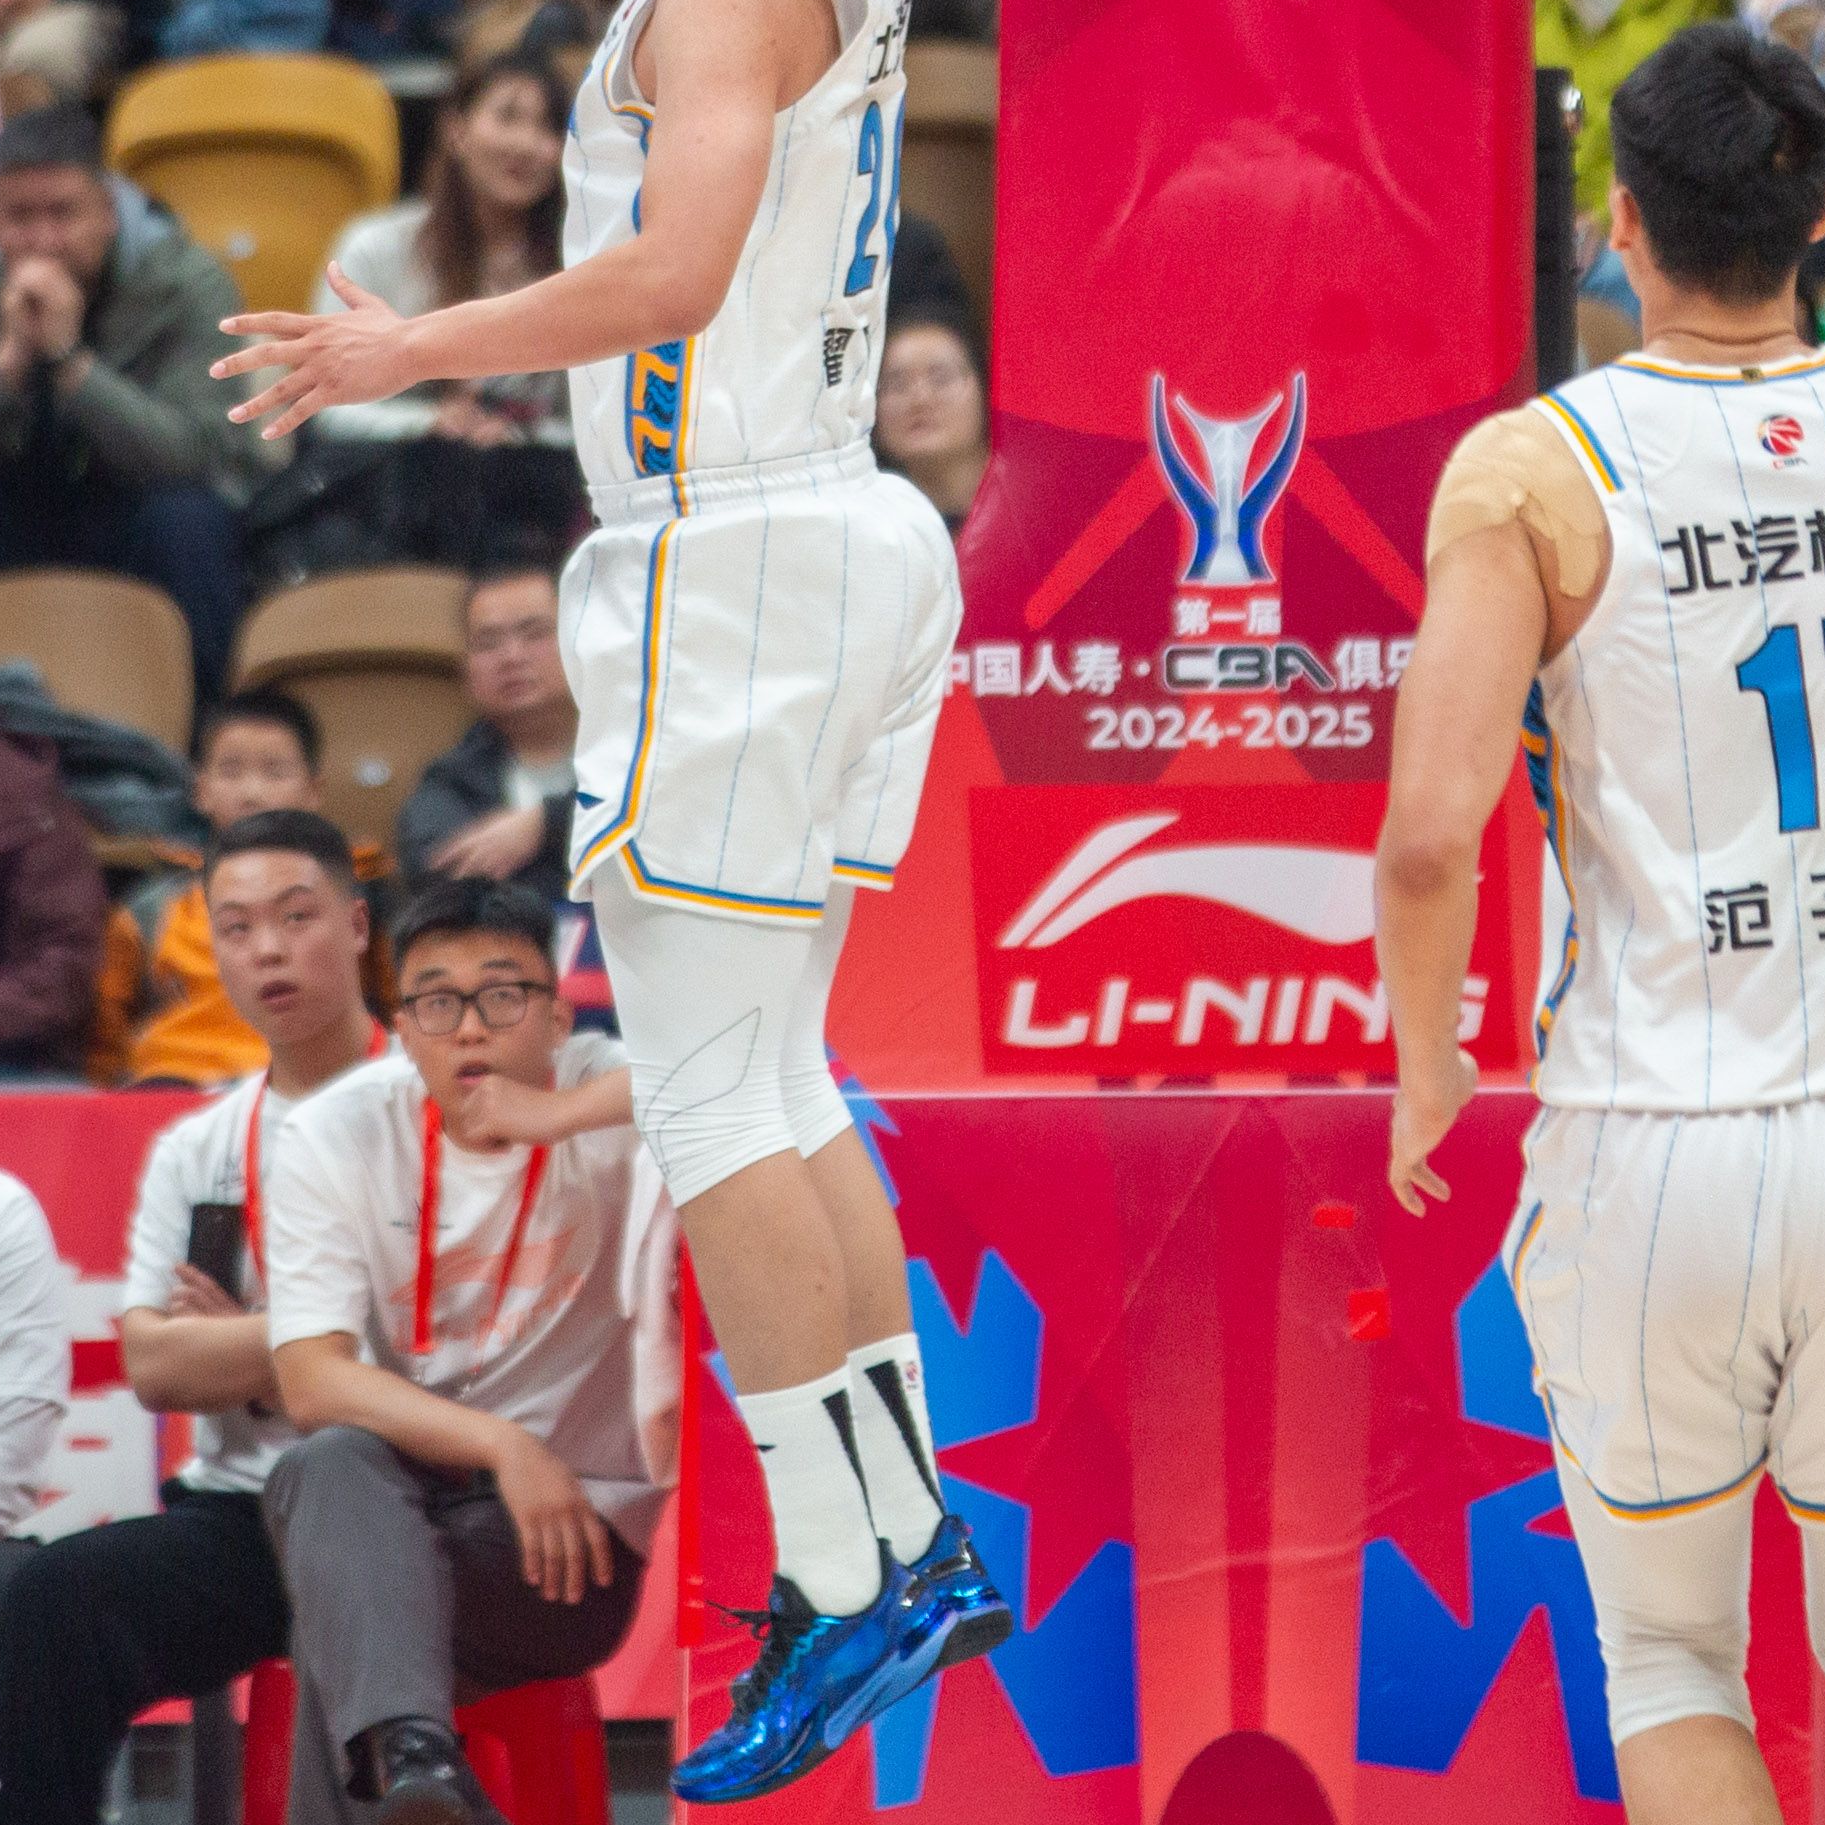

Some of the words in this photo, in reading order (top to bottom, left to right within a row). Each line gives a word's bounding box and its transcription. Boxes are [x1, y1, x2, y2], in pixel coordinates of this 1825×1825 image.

[1177, 599, 1282, 635] 第一届
[1087, 704, 1374, 751] 2024-2025
